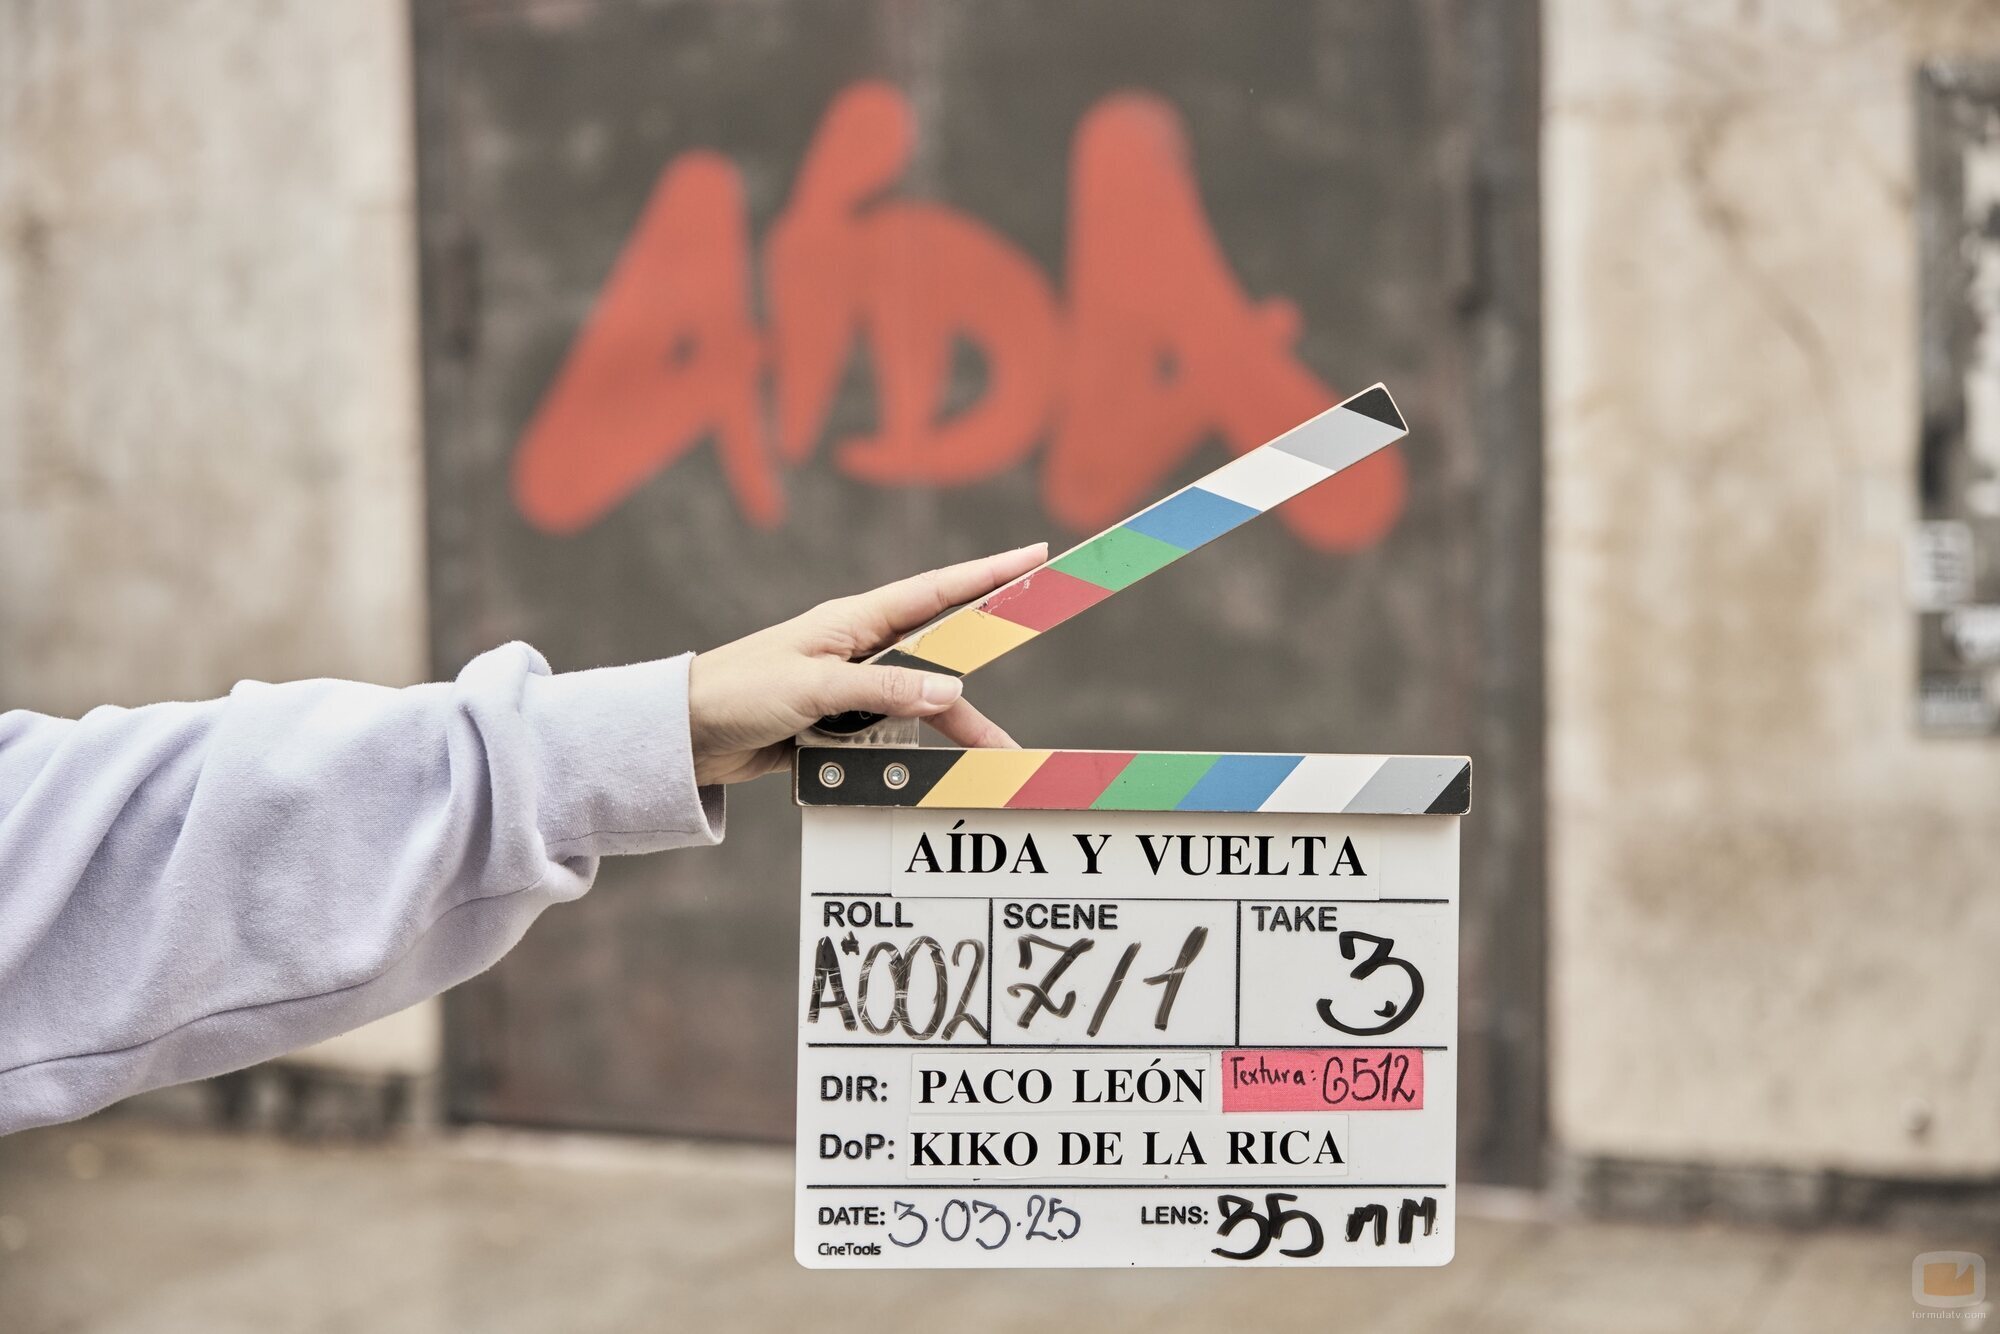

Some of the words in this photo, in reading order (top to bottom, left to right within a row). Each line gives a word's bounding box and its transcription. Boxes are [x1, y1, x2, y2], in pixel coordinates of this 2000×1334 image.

[511, 79, 1407, 552] AÍDA
[904, 819, 1049, 874] AÍDA
[1072, 834, 1113, 875] Y
[1135, 835, 1368, 877] VUELTA
[823, 901, 914, 928] ROLL
[1003, 903, 1119, 930] SCENE
[1250, 905, 1338, 932] TAKE
[1316, 930, 1425, 1037] 3
[820, 1075, 888, 1102] DIR:
[919, 1068, 1053, 1105] PACO
[1072, 1058, 1206, 1104] LEÓN
[1230, 1055, 1317, 1090] Textura:
[819, 1134, 895, 1161] DoP:
[910, 1131, 1039, 1167] KIKO
[1057, 1131, 1124, 1166] DE
[1142, 1131, 1208, 1166] LA
[1226, 1131, 1346, 1165] RICA
[818, 1206, 886, 1226] DATE:
[1141, 1205, 1209, 1225] LENS:
[1211, 1193, 1325, 1260] 35
[818, 1243, 882, 1256] CineTools
